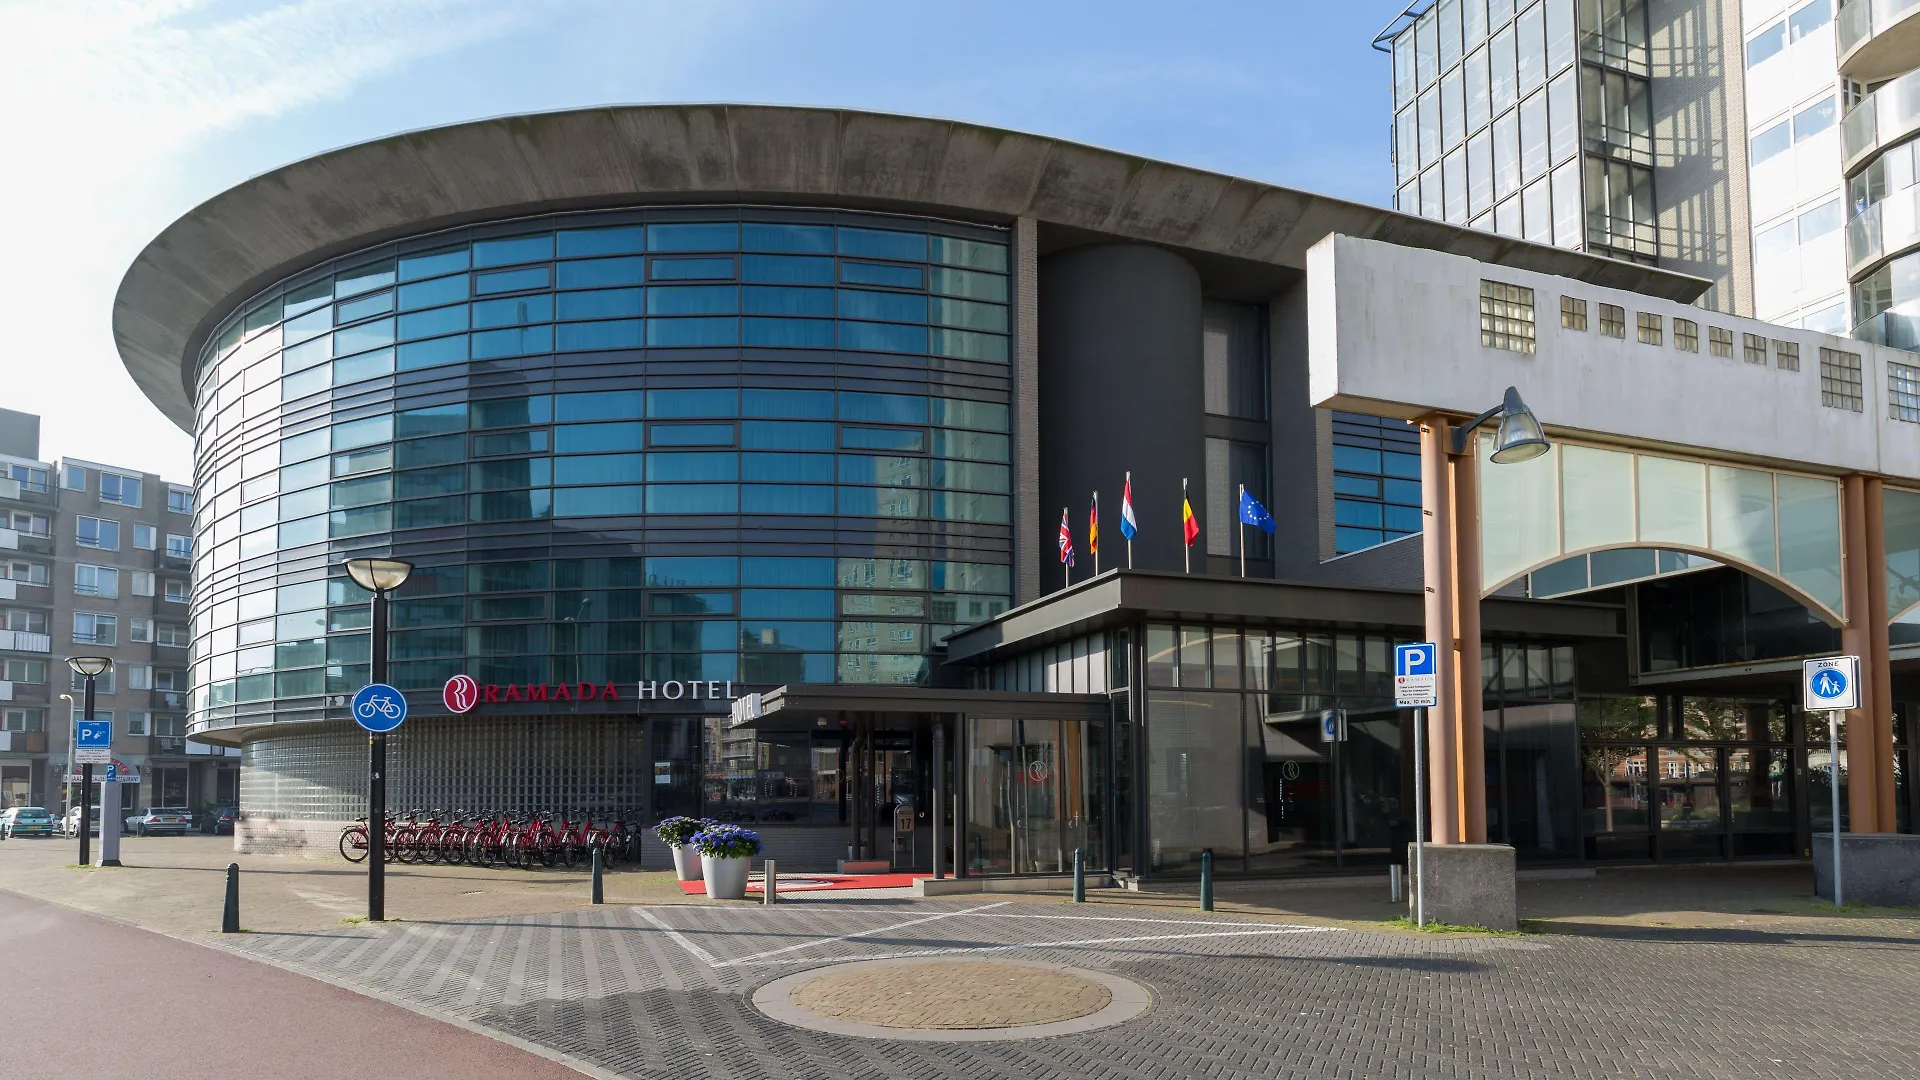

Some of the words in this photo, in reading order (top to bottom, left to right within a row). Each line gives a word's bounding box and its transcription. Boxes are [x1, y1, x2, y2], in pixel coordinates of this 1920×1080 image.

[484, 682, 620, 702] RAMADA
[638, 680, 738, 700] HOTEL
[731, 693, 762, 725] HOTEL
[900, 818, 912, 830] 17
